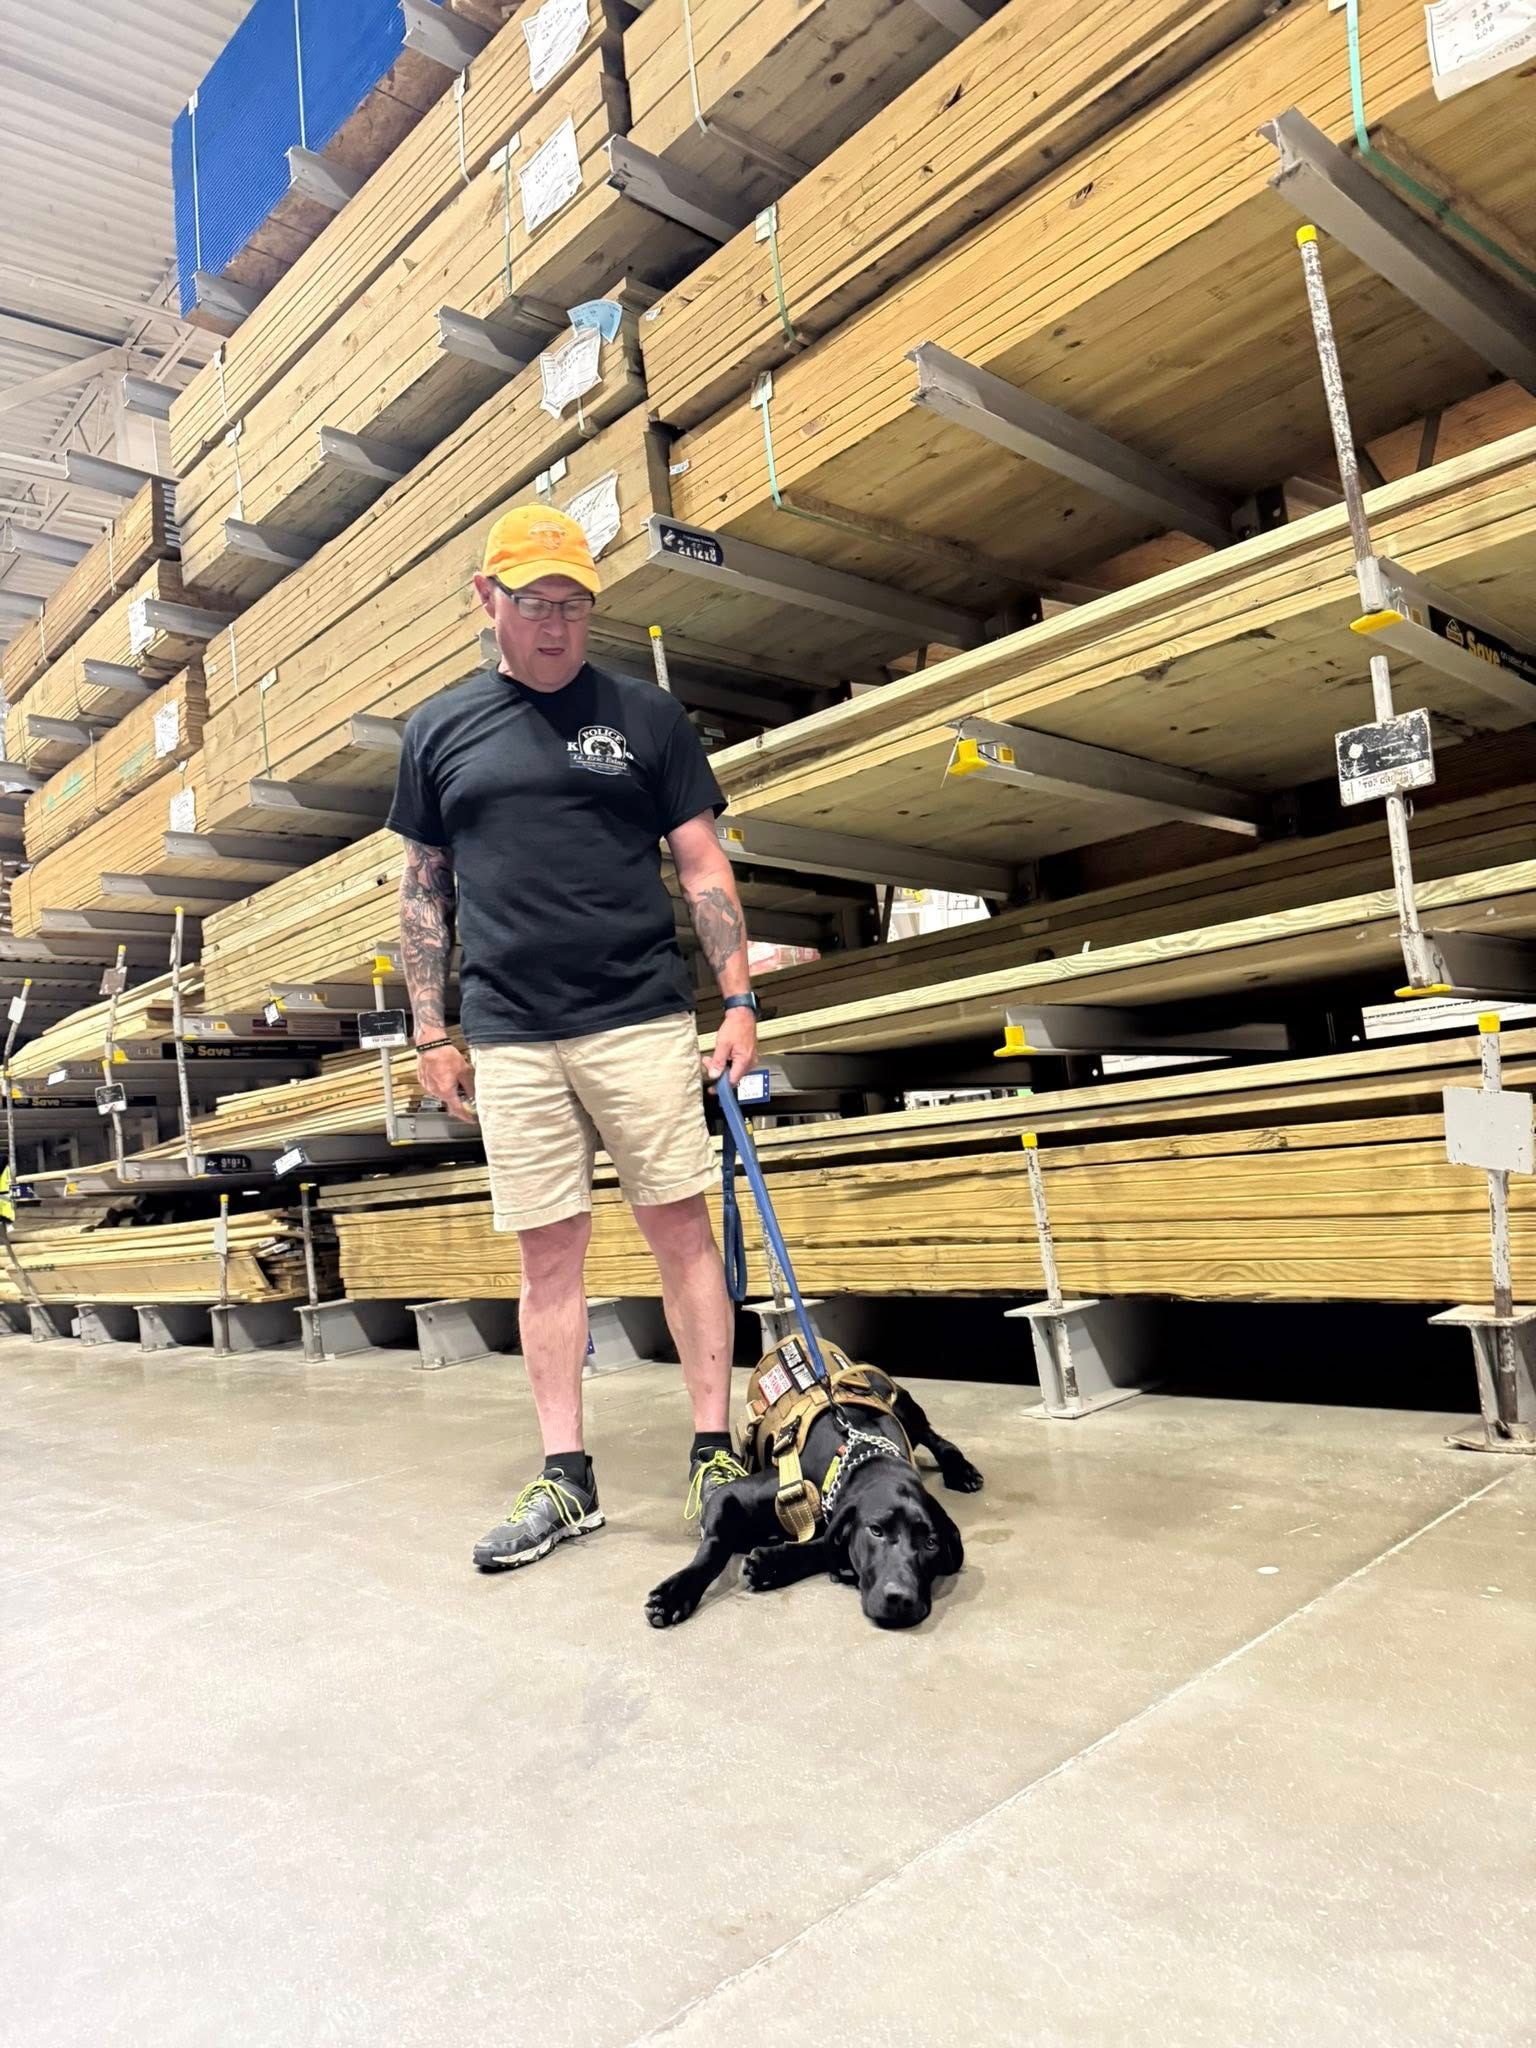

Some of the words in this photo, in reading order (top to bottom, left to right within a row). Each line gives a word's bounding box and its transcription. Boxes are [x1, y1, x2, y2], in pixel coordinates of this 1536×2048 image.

[581, 728, 624, 744] POLICE
[197, 1045, 231, 1057] Save
[31, 1099, 61, 1107] Save
